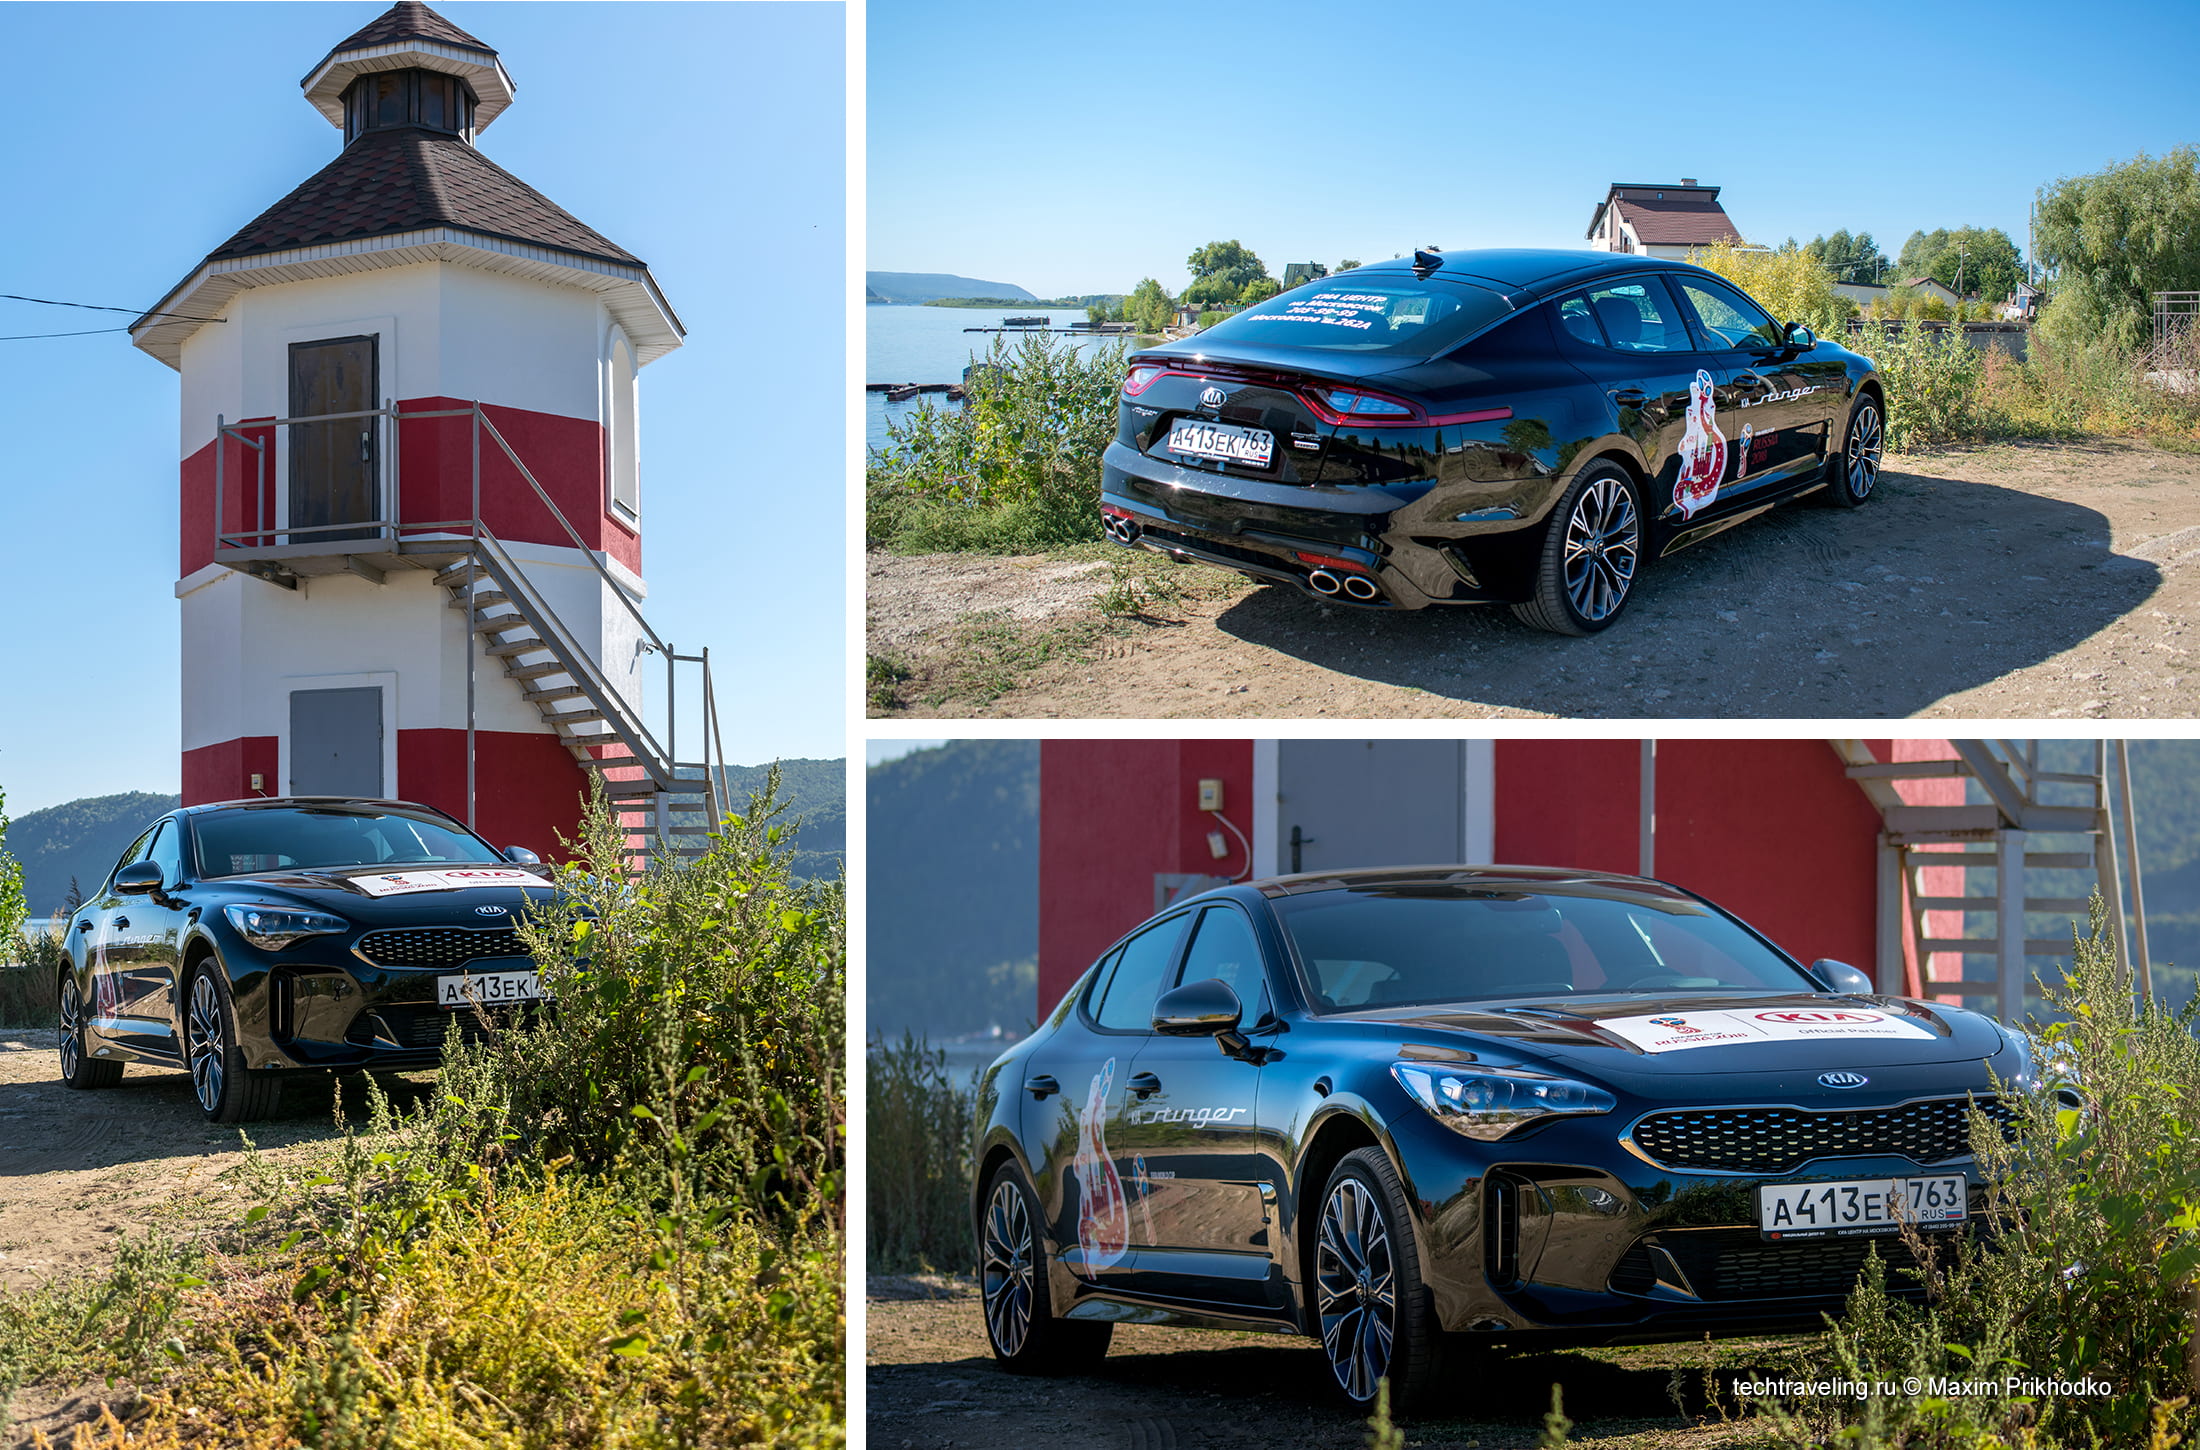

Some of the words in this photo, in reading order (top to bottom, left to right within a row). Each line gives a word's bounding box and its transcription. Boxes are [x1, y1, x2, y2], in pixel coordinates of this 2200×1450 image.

[1202, 389, 1222, 404] KIA
[1242, 430, 1271, 452] 763
[1244, 450, 1259, 459] RUS
[1779, 1013, 1869, 1023] KIA
[1826, 1074, 1862, 1084] KIA
[1909, 1180, 1956, 1209] 763
[1922, 1207, 1945, 1219] RUS
